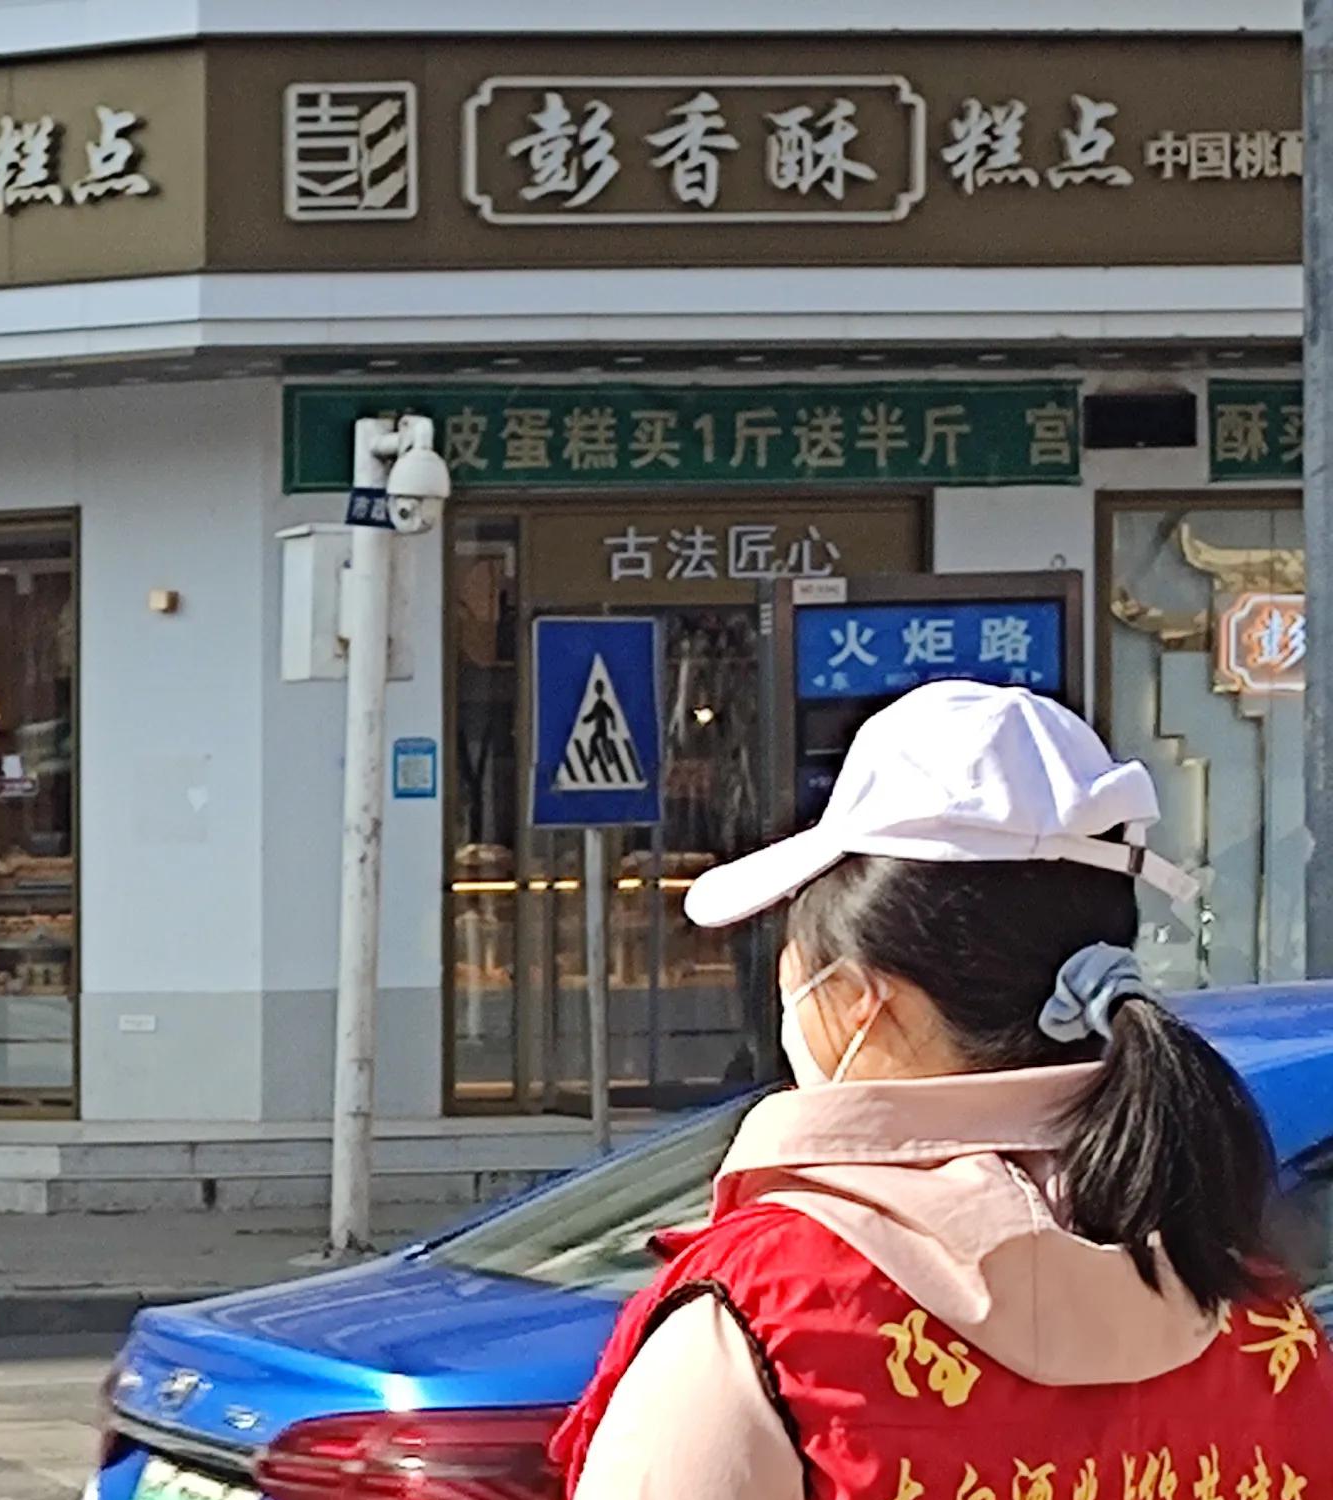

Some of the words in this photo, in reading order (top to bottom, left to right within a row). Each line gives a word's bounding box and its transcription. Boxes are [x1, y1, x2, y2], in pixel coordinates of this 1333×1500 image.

[508, 92, 877, 208] 彭香酥
[941, 95, 1133, 188] 糕点
[377, 402, 972, 472] 皮蛋糕买1斤送半斤
[603, 525, 840, 581] 古法匠心
[827, 616, 1032, 667] 火炬路
